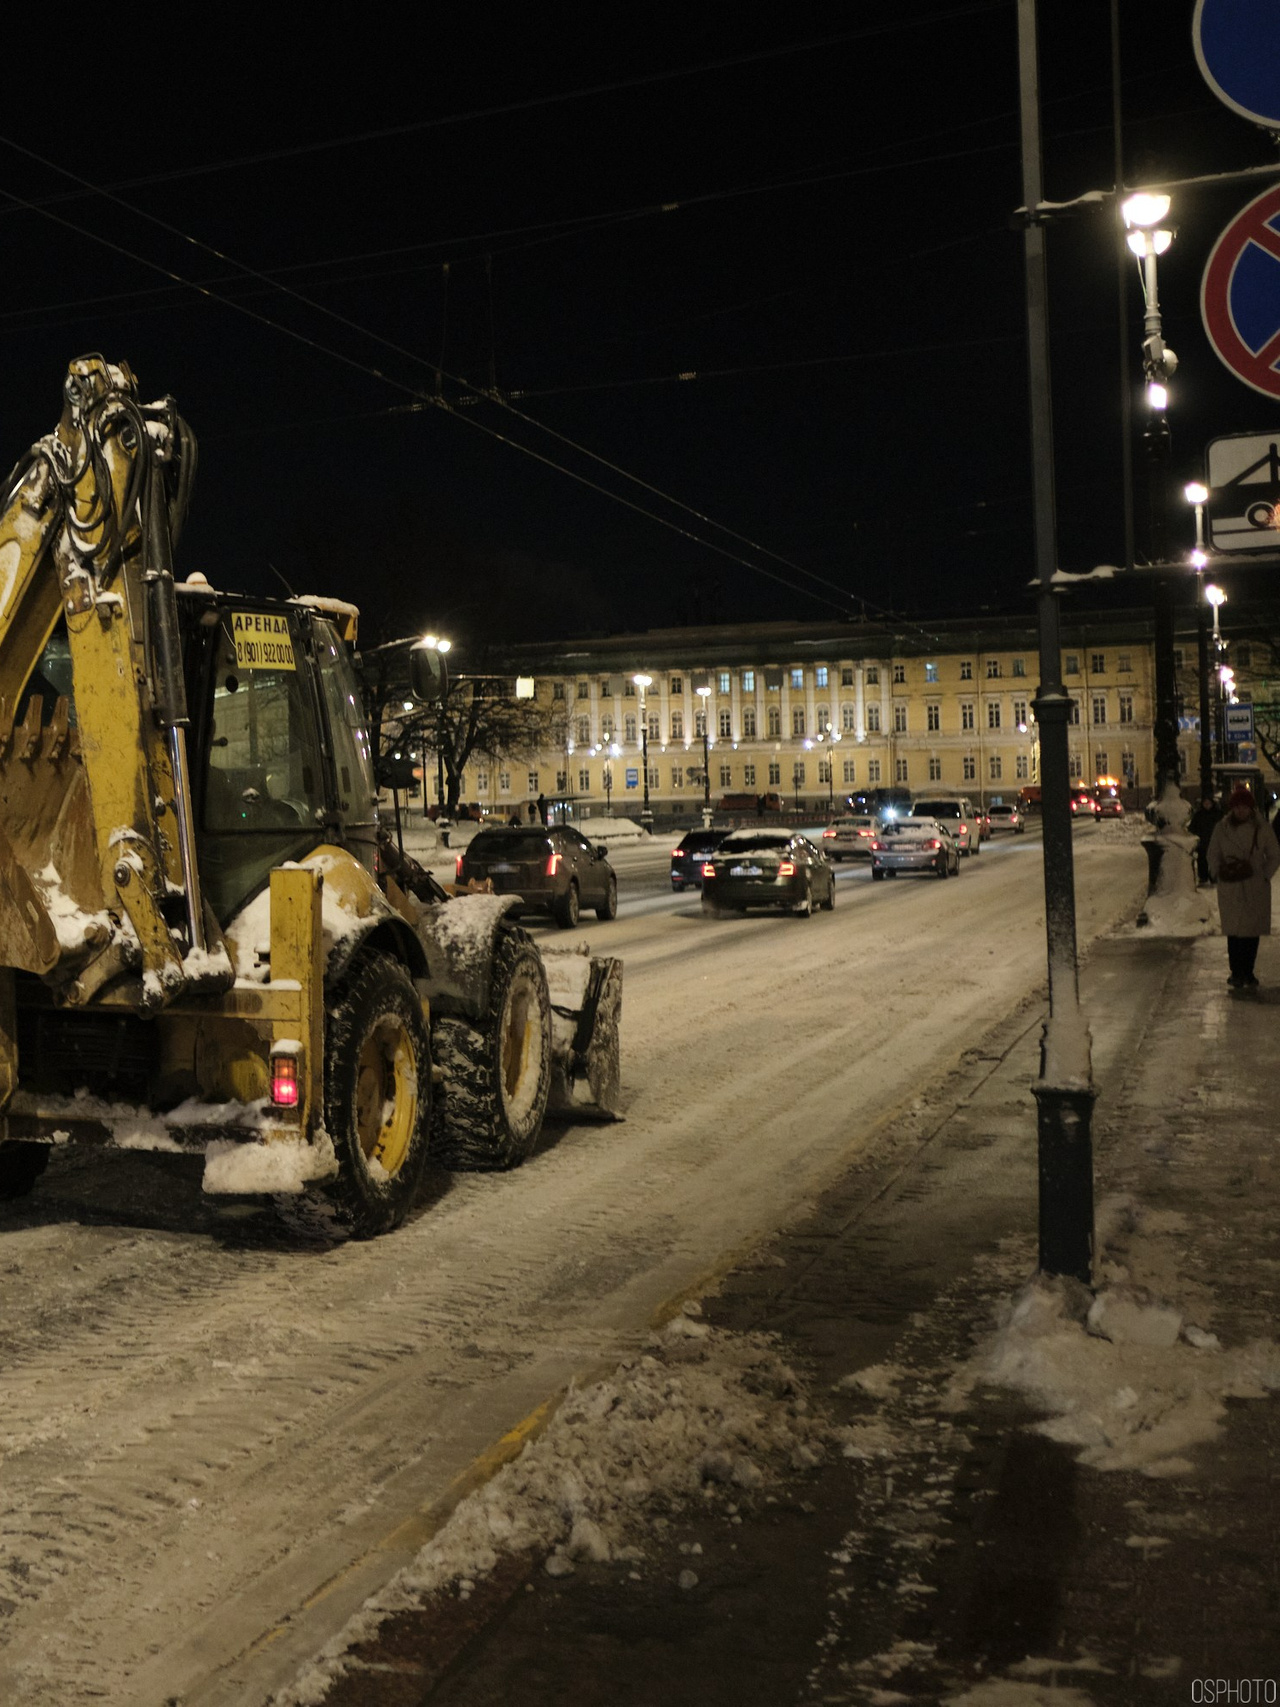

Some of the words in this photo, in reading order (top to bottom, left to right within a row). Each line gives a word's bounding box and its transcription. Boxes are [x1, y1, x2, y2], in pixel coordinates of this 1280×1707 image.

[235, 616, 287, 634] АРЕНДА
[237, 642, 243, 663] 8
[244, 640, 263, 665] (901)
[263, 643, 276, 663] 922
